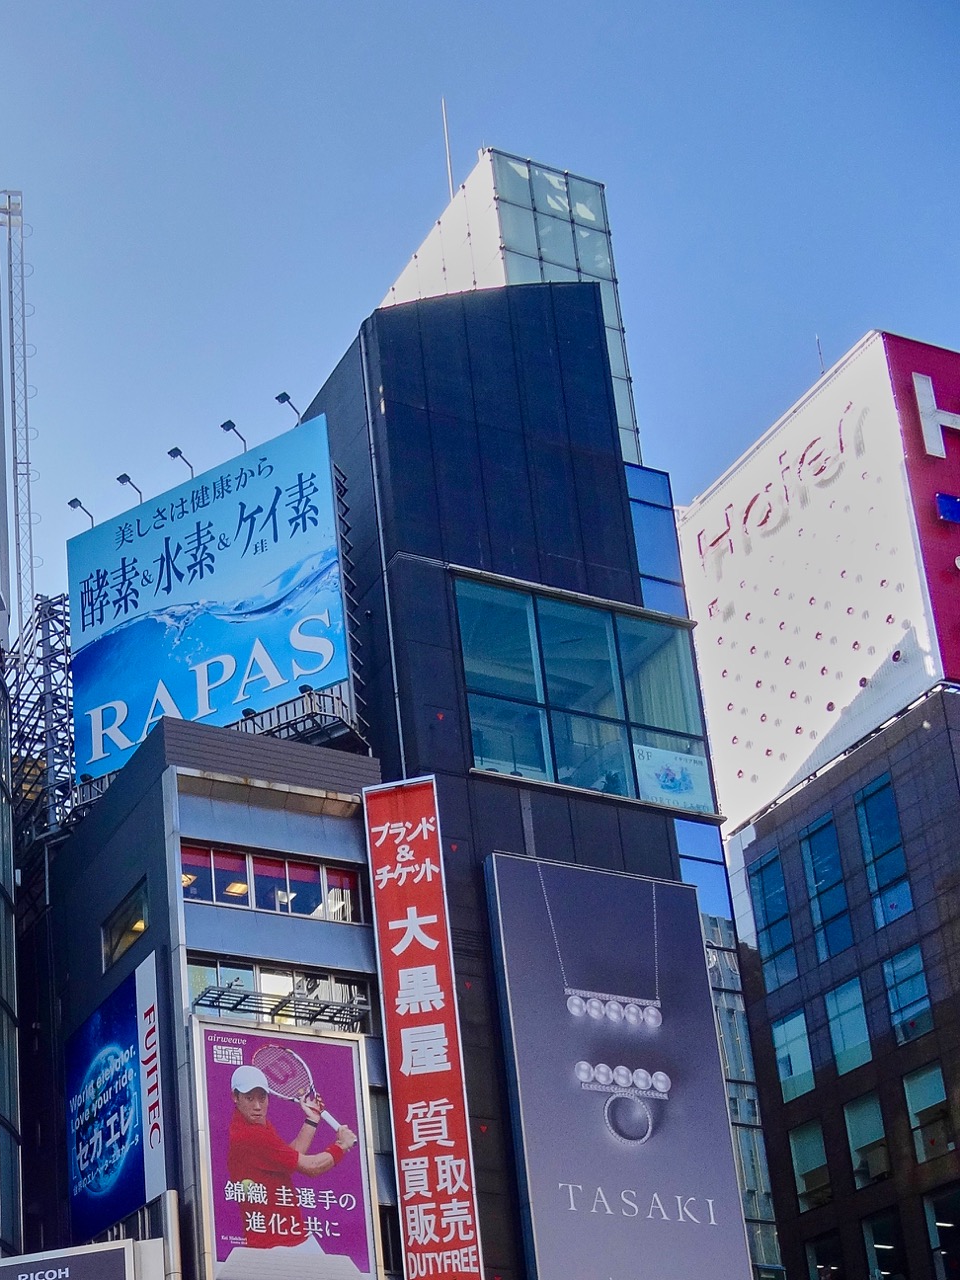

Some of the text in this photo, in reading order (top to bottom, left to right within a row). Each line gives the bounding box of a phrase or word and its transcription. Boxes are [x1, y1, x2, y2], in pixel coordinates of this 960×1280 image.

[115, 457, 274, 550] 美しさは健康から
[85, 608, 335, 766] RAPAS
[637, 748, 652, 761] 8F
[370, 815, 437, 849] ブランド
[396, 846, 413, 862] &
[375, 862, 440, 890] チケット
[207, 1034, 247, 1045] airweave
[141, 1003, 162, 1150] FUJITEC
[69, 1080, 94, 1114] World
[70, 1067, 137, 1135] Love your ride.
[406, 1098, 456, 1153] 質
[224, 1180, 357, 1211] 錦織 圭選手の
[558, 1181, 718, 1226] TASAKI
[245, 1211, 341, 1239] 進化と共に
